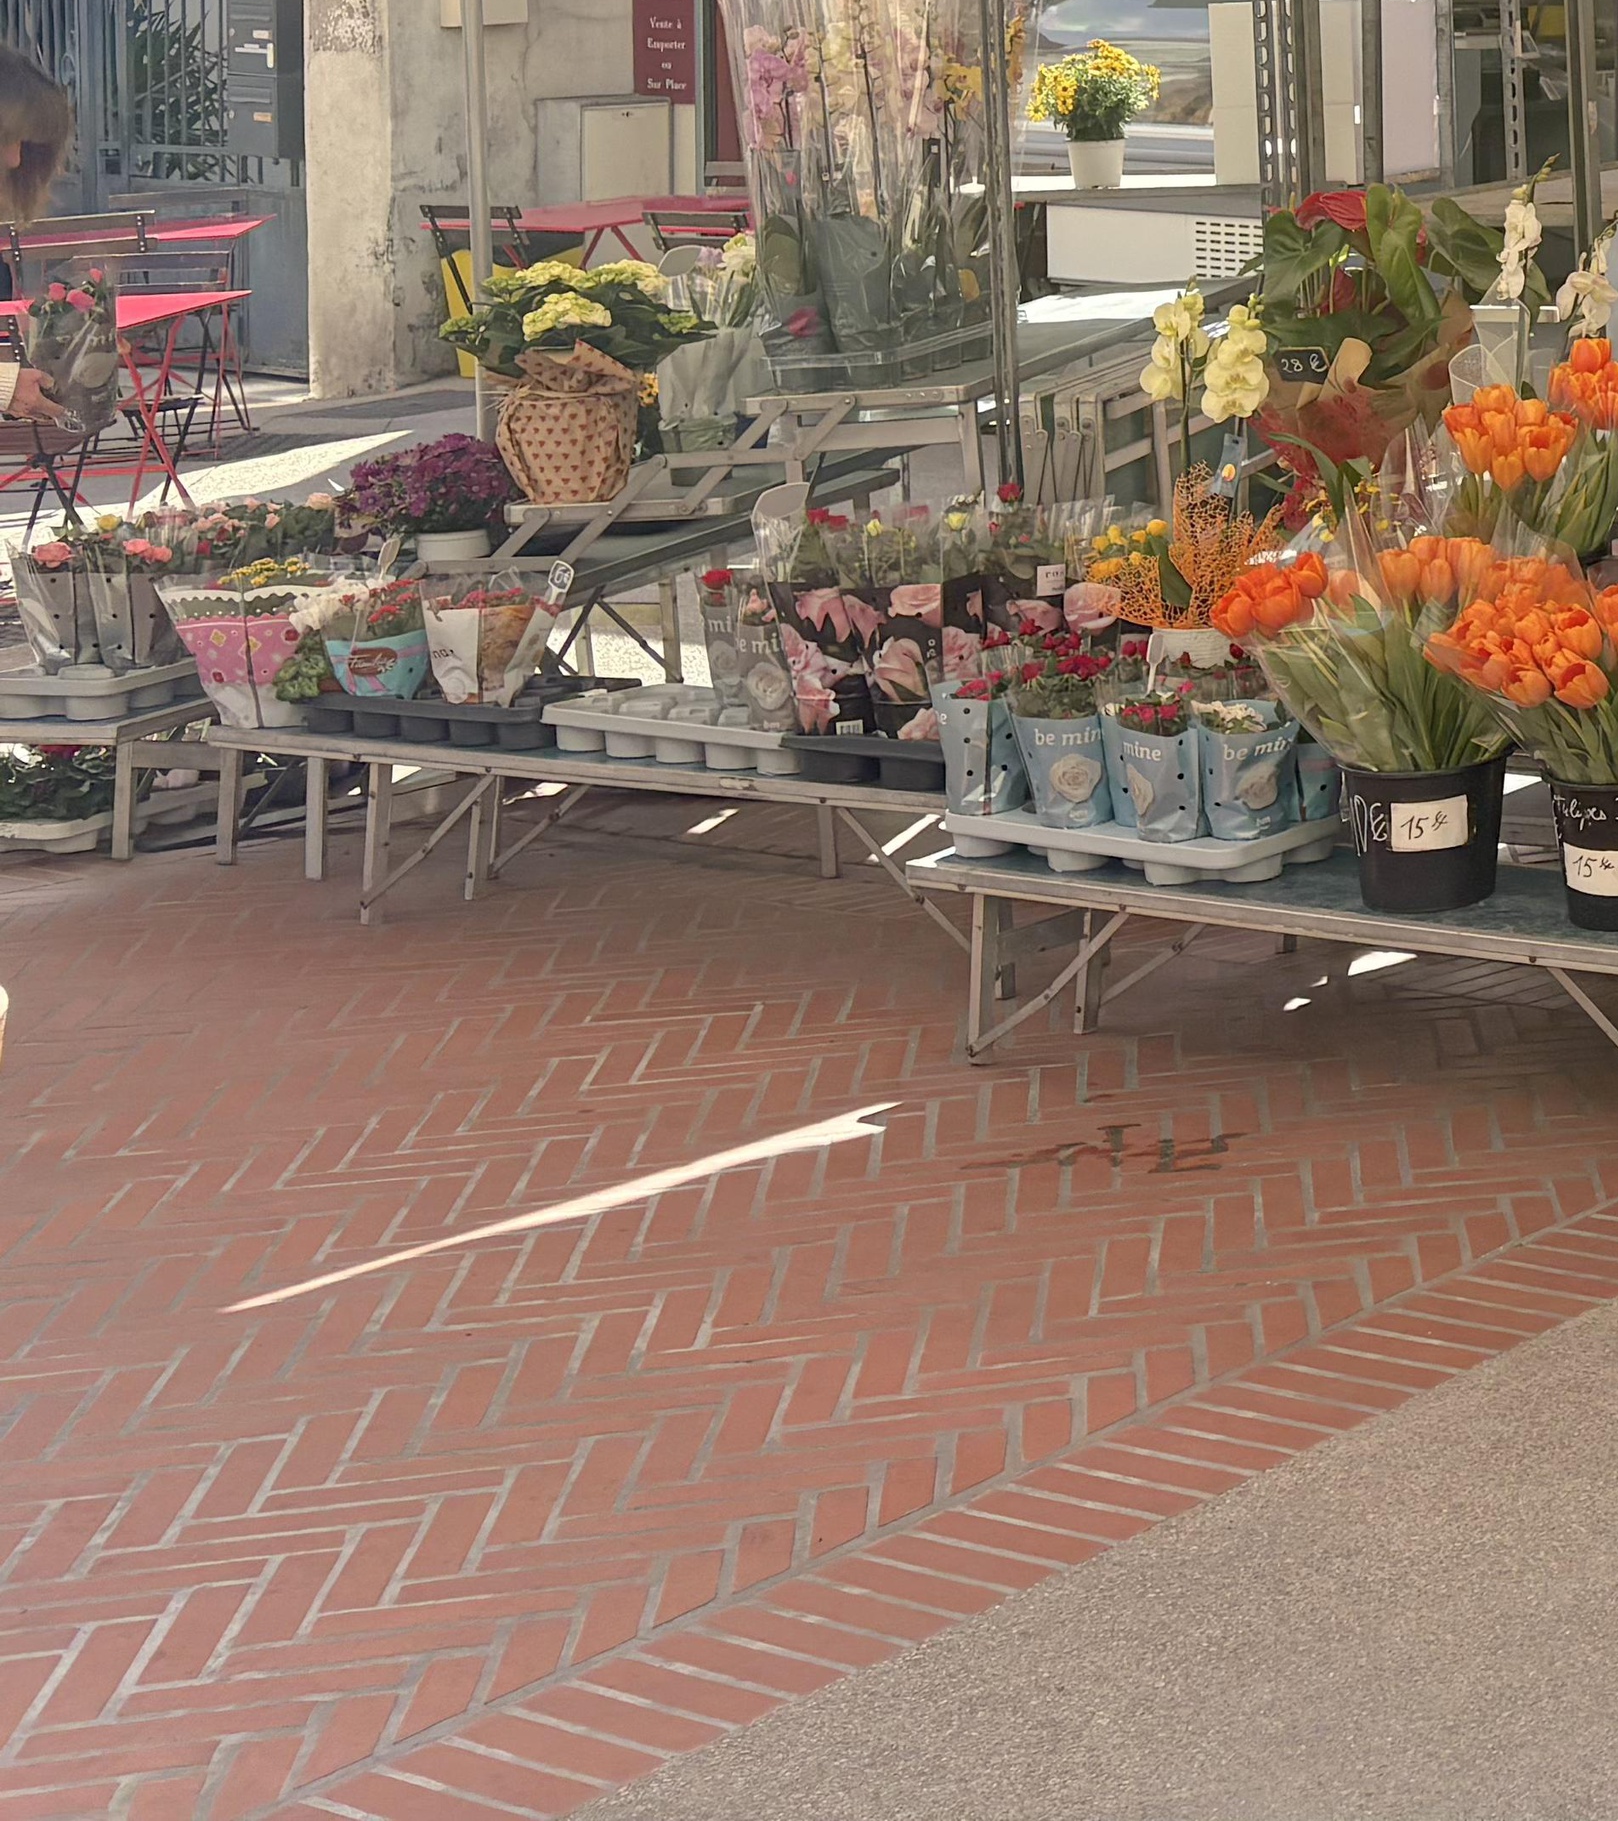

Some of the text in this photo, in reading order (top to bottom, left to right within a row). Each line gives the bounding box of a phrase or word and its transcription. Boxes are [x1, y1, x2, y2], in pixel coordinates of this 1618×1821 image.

[1281, 358, 1303, 373] 28
[1034, 726, 1103, 746] be min
[1123, 741, 1162, 761] mine
[1224, 744, 1248, 761] be
